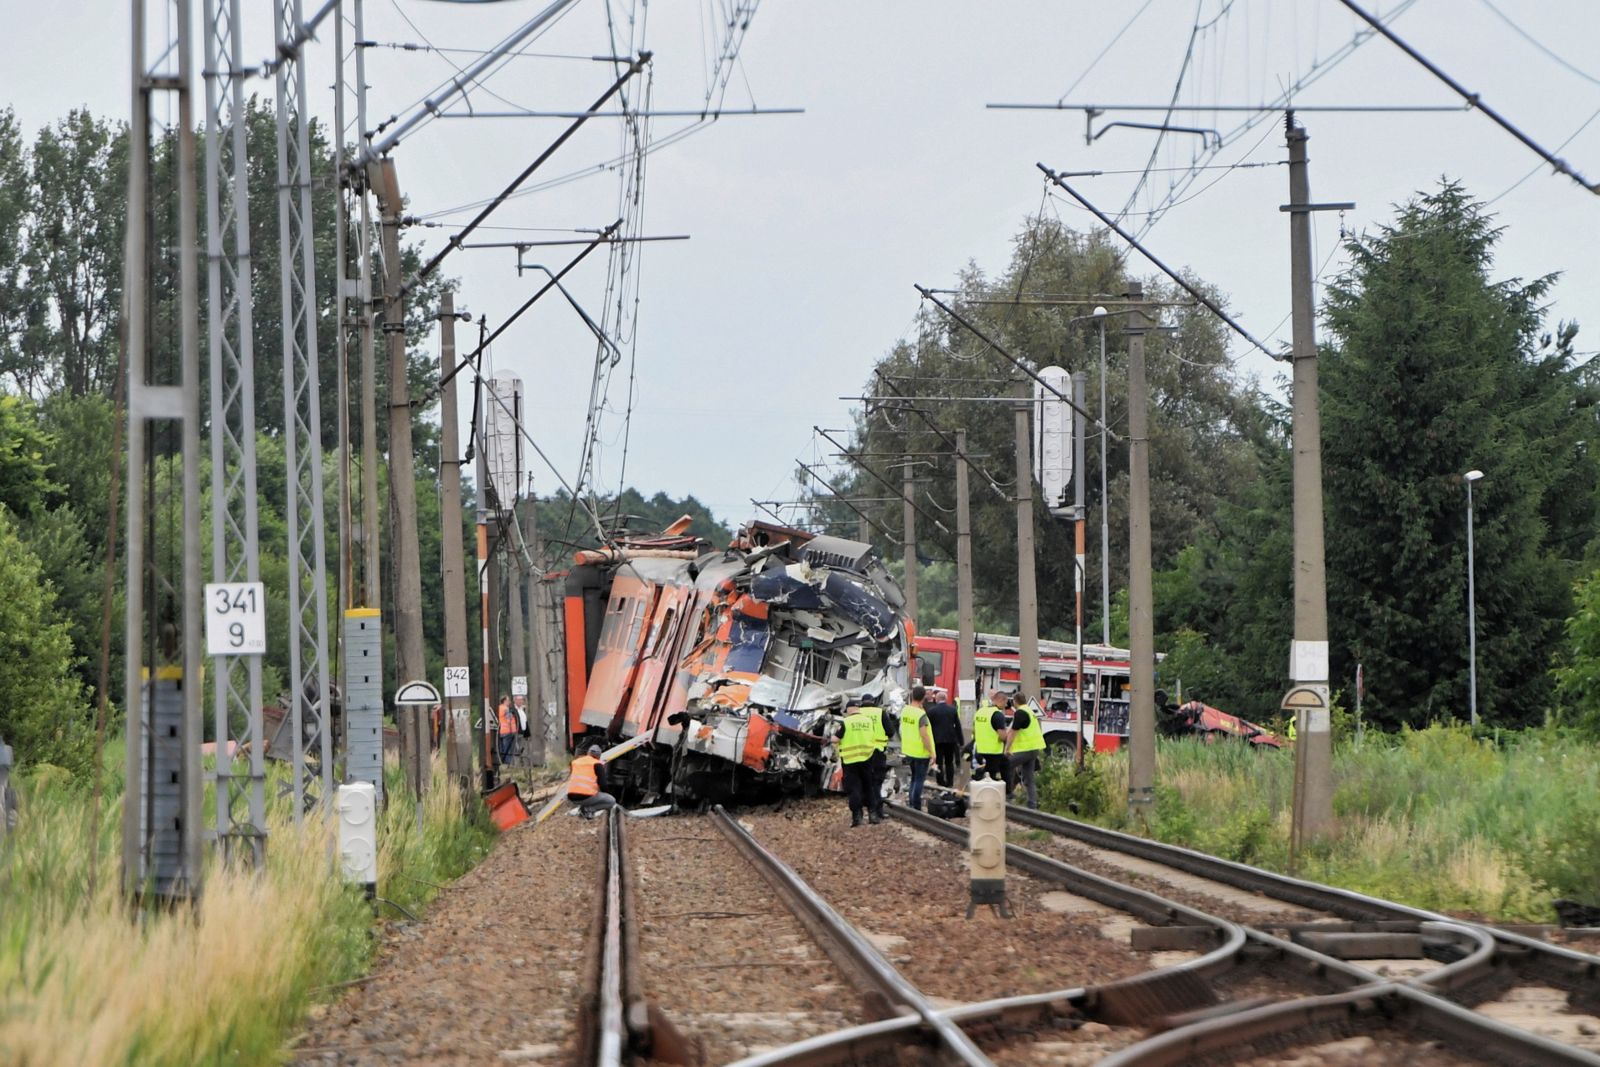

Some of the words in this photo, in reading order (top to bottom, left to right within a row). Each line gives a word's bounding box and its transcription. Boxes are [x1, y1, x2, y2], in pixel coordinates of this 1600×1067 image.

[216, 587, 256, 614] 341
[229, 622, 245, 647] 9
[446, 668, 467, 680] 342
[455, 683, 459, 694] 1
